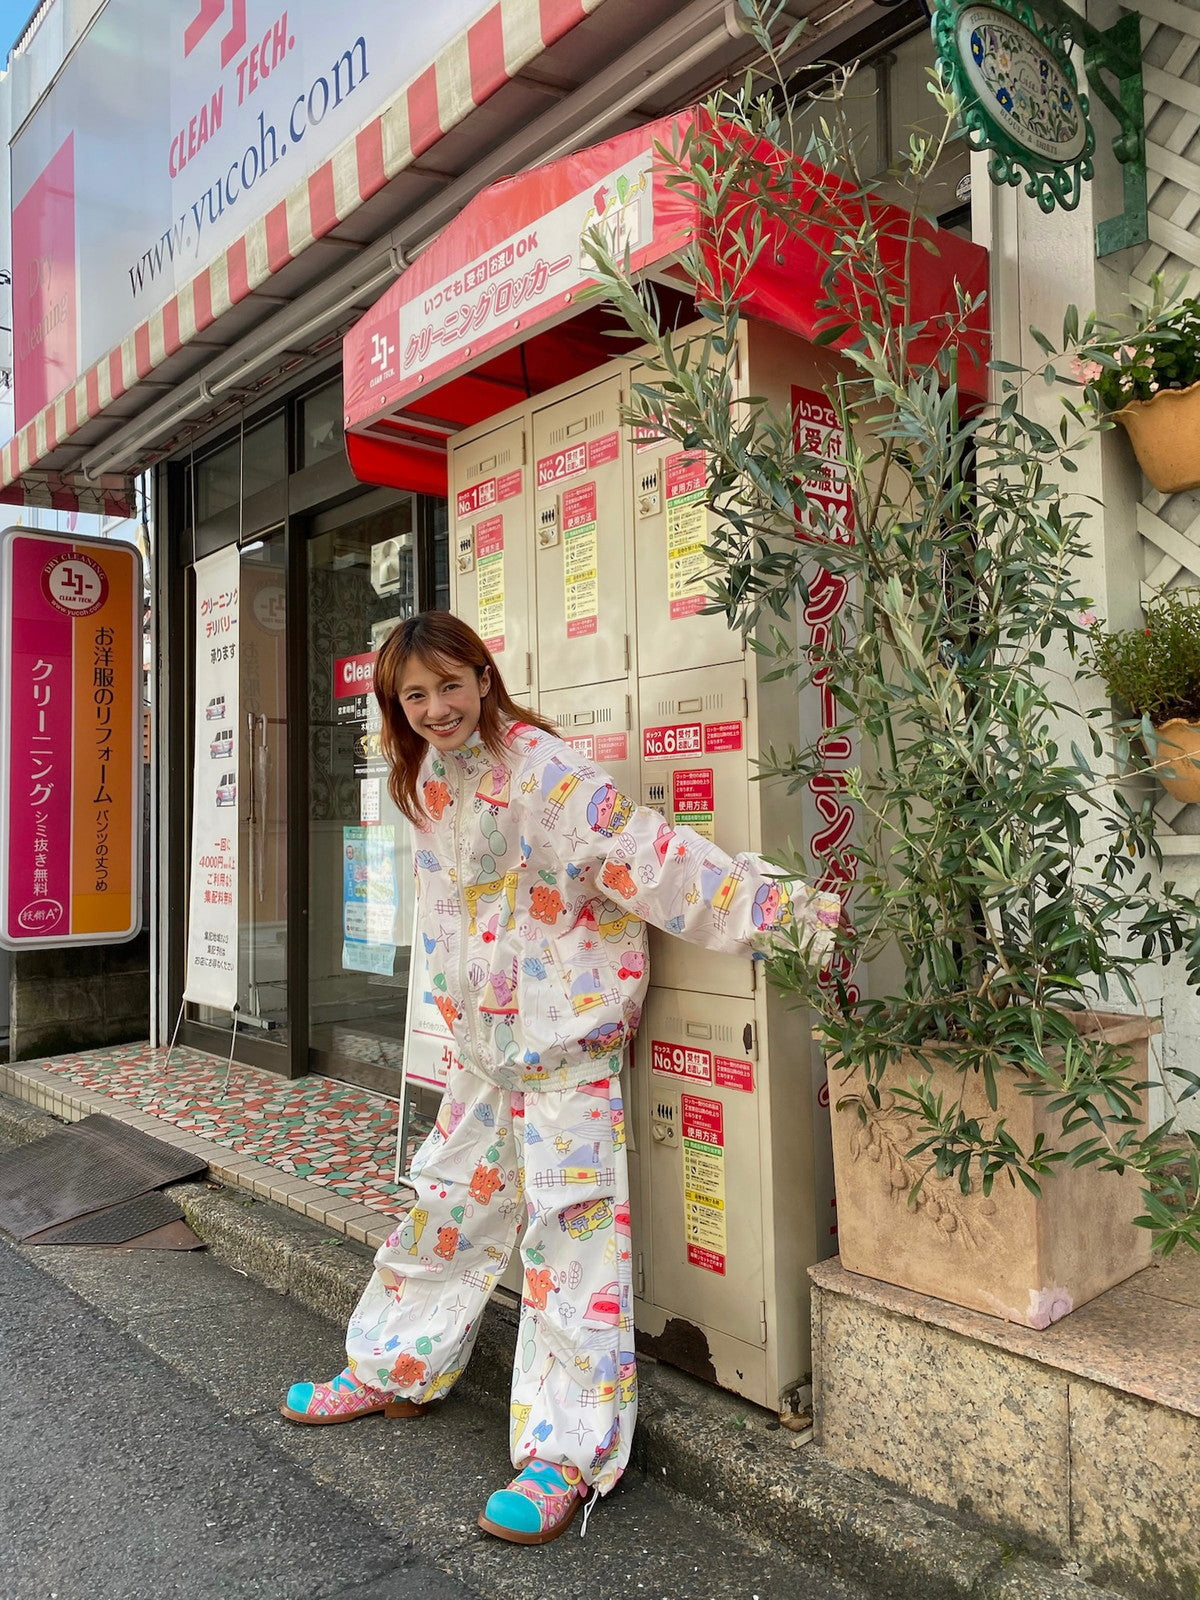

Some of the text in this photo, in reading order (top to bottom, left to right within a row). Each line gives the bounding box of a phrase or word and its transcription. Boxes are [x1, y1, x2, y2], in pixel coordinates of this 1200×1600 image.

[169, 10, 295, 179] CLEAN TECH.
[128, 36, 370, 299] www.yucoh.com
[403, 254, 573, 369] クリーニングロッカー
[805, 427, 842, 459] 受付
[670, 478, 701, 496] 使用方法
[567, 512, 592, 527] 使用方法
[45, 553, 106, 580] DRY CLEANING
[51, 600, 102, 616] www.yucoh.com
[206, 615, 237, 638] デリバリー
[211, 643, 236, 664] 承ります
[93, 627, 115, 803] お洋服のリフォーム
[29, 659, 54, 806] クリーニング
[679, 801, 708, 811] 使用方法
[33, 810, 48, 896] シミ抜き無料
[95, 810, 109, 891] パンツの丈つめ
[687, 1127, 718, 1143] 使用方法
